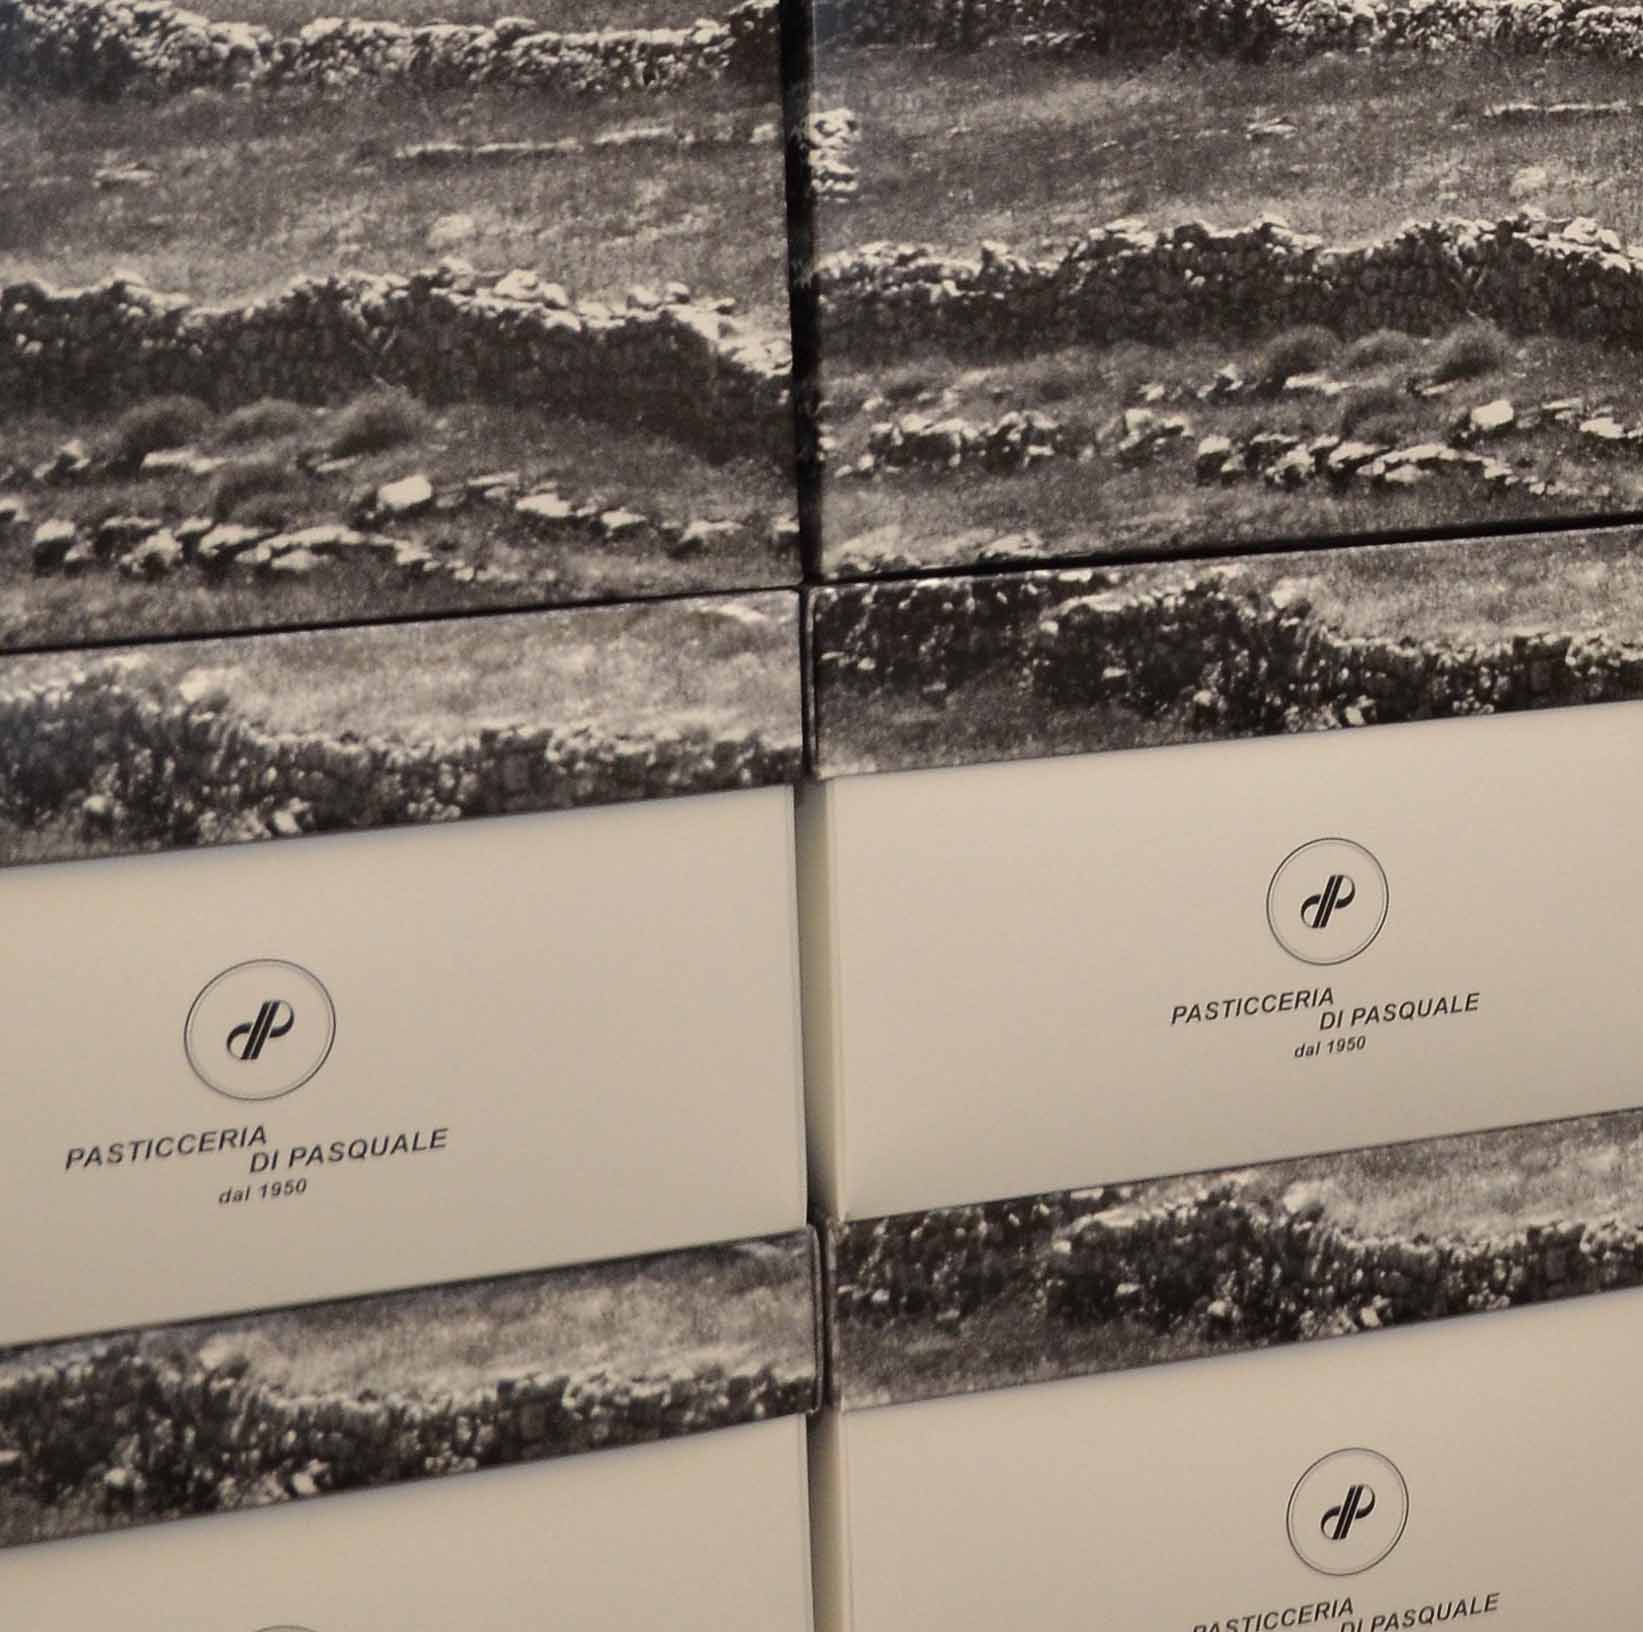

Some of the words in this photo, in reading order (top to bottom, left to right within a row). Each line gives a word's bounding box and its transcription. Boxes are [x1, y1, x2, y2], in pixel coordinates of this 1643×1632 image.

[1170, 987, 1334, 1026] PASTICCERIA
[1319, 1010, 1343, 1031] DI
[1350, 992, 1480, 1027] PASQUALE
[1294, 1041, 1320, 1058] dal
[1326, 1035, 1366, 1055] 1950
[65, 1125, 267, 1171] PASTICCERIA
[249, 1149, 278, 1174] DI
[288, 1128, 450, 1168] PASQUALE
[218, 1185, 250, 1205] dal
[259, 1178, 308, 1199] 1950
[1369, 1592, 1501, 1632] PASQUALE
